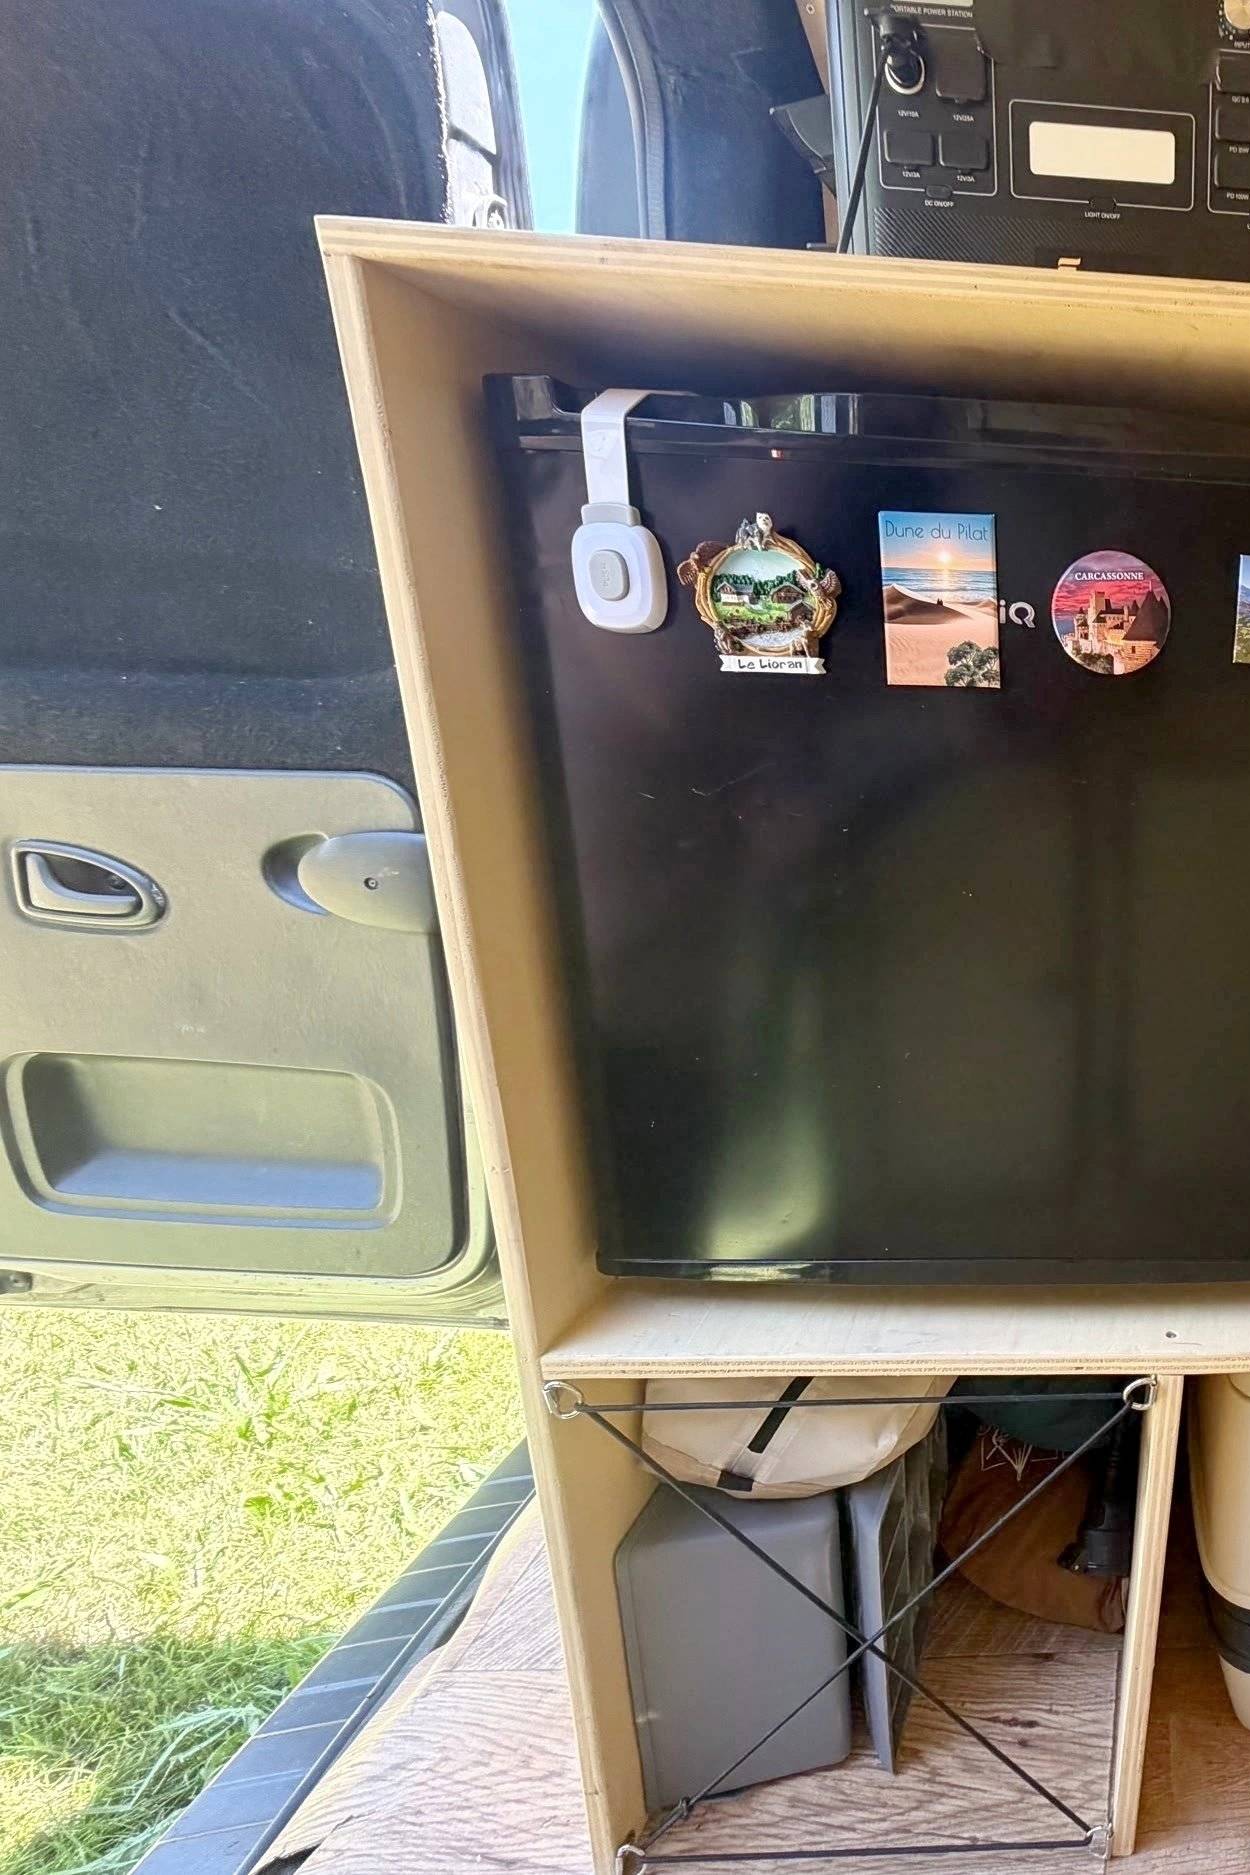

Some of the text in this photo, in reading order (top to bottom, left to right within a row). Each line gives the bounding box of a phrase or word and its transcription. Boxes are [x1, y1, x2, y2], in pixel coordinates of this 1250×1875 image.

[923, 7, 946, 16] POWER
[947, 8, 973, 18] STATION
[934, 200, 954, 208] ON/OFF
[885, 520, 989, 541] Dune du Pilat
[1074, 572, 1144, 581] CARCASSONNE
[738, 659, 803, 670] Le Lioran
